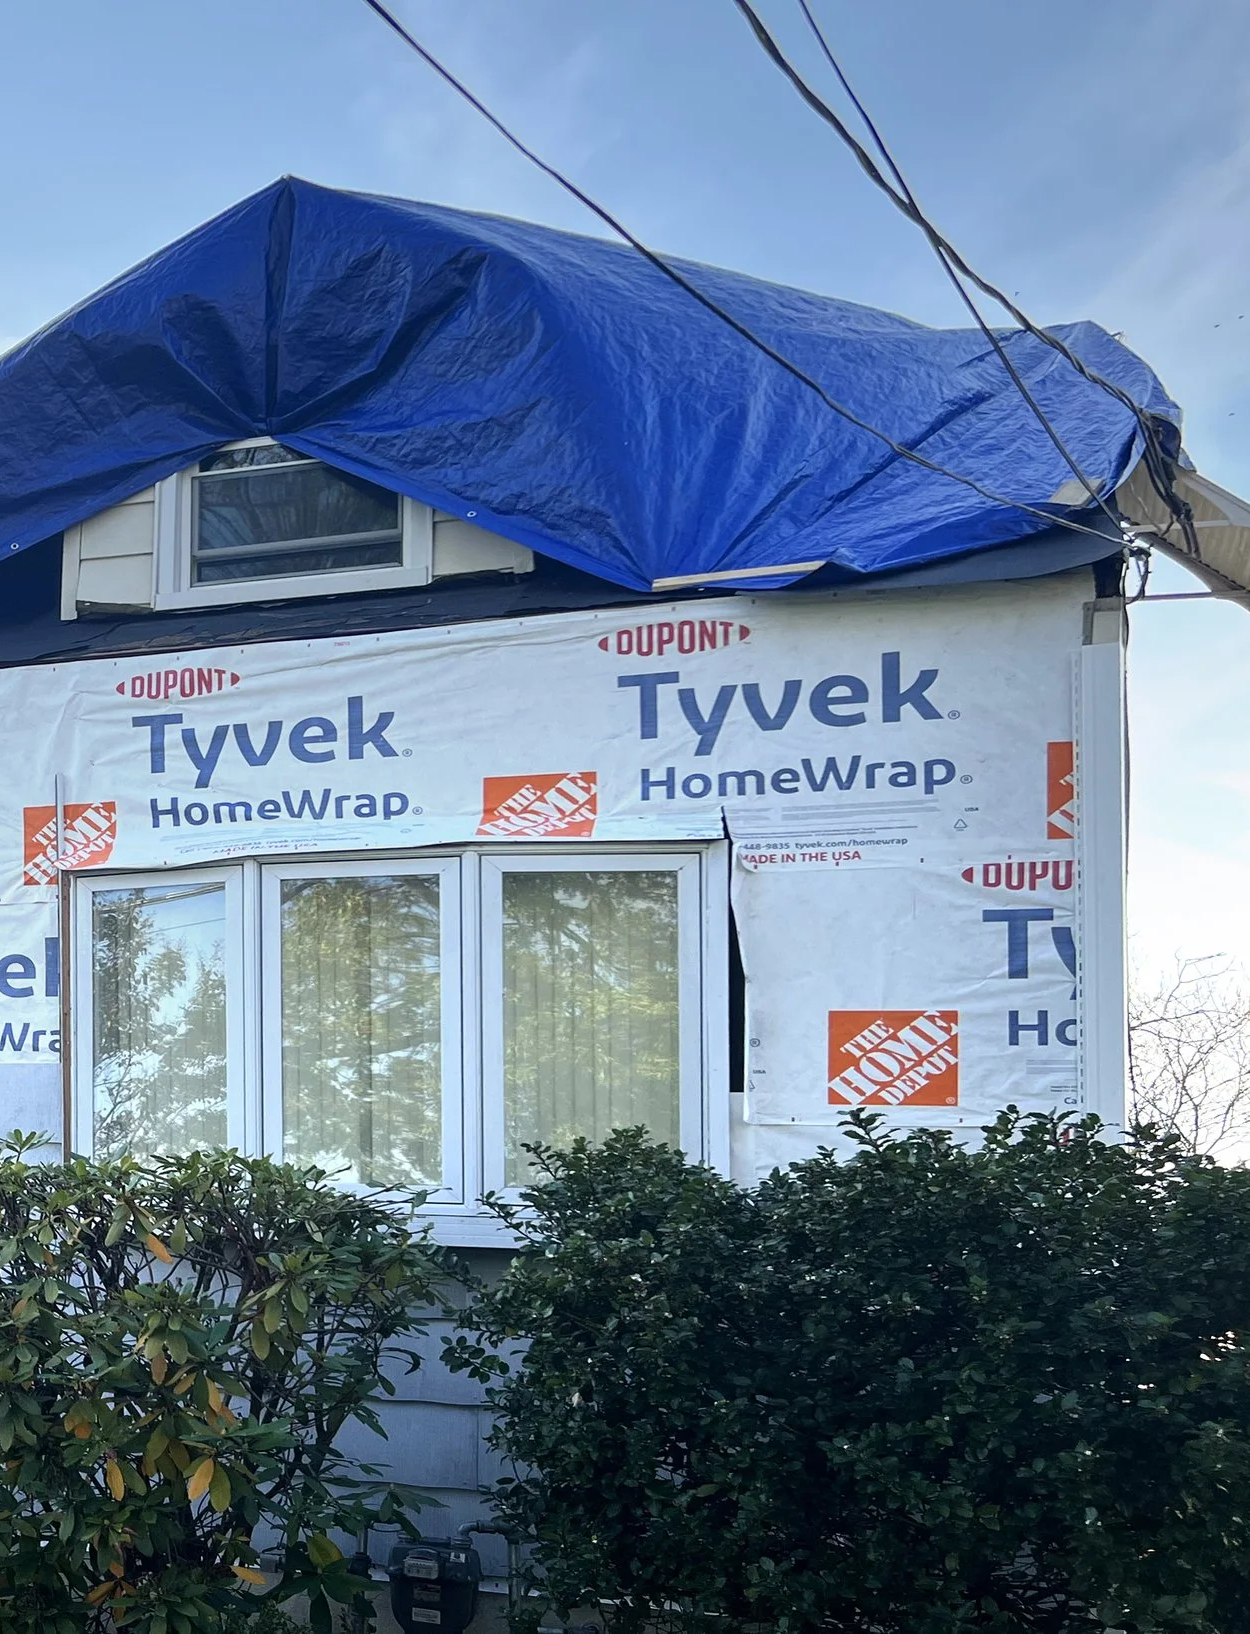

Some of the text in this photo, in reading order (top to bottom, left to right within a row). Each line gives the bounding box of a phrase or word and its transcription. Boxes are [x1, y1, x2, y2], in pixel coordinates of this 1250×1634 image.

[616, 620, 734, 656] DUPONT
[131, 667, 226, 699] DUPONT
[617, 651, 944, 756] Tyvek
[132, 696, 399, 788] Tyvek
[641, 755, 957, 801] HomeWrap
[151, 788, 409, 828] HomeWrap
[478, 773, 597, 836] HOME
[494, 784, 542, 817] THE
[521, 805, 597, 836] DEPOT
[781, 853, 796, 863] IN
[801, 852, 828, 863] THE
[832, 850, 862, 861] USA
[795, 837, 908, 849] tyvek.com/homewrap
[827, 1010, 959, 1106] HOME
[839, 1020, 894, 1058] THE
[877, 1045, 959, 1106] DEPOT
